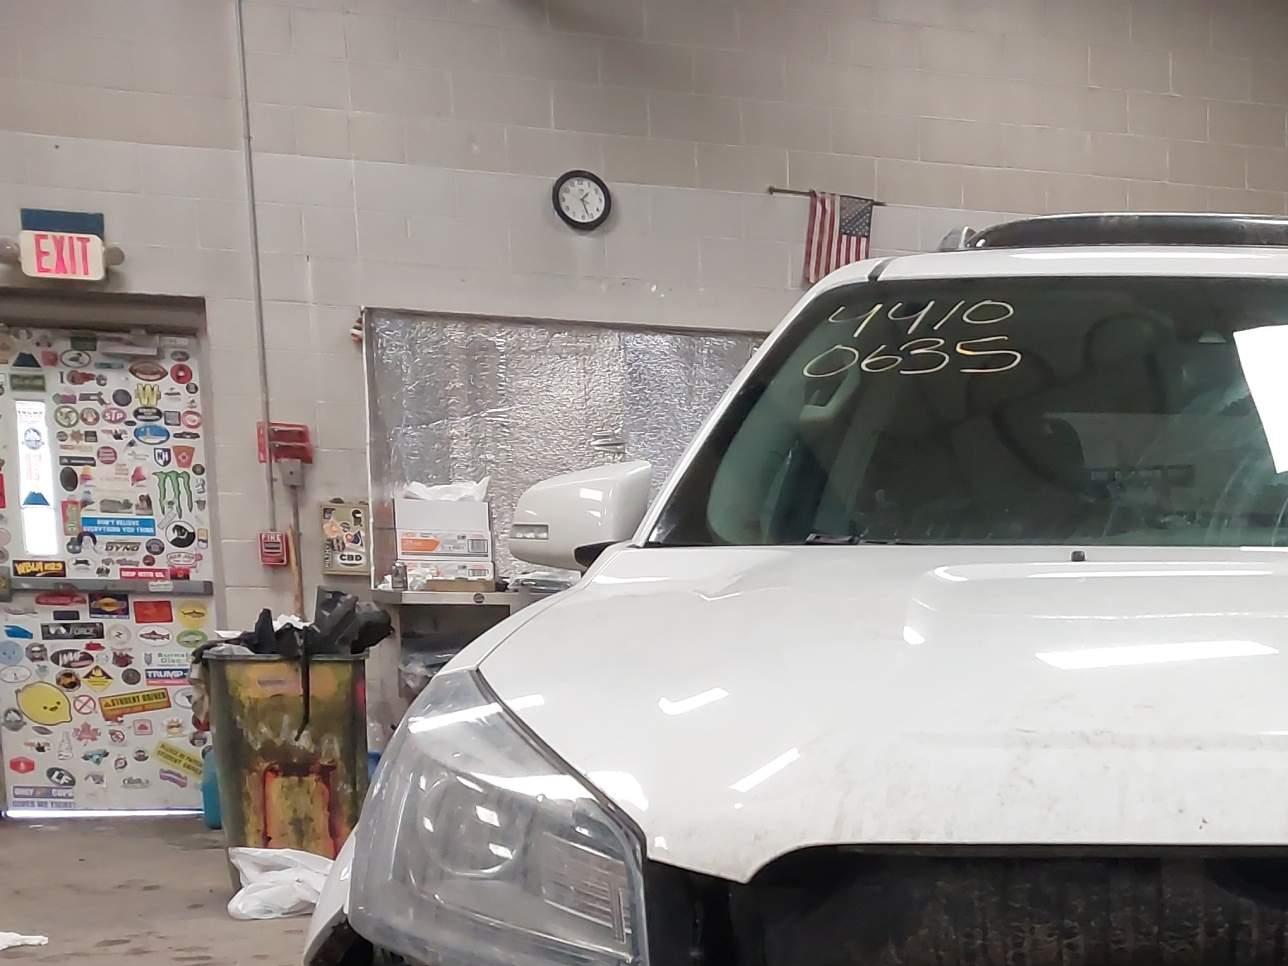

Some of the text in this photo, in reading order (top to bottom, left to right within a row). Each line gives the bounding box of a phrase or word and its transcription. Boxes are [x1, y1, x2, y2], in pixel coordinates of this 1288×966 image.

[34, 233, 91, 276] EXIT
[827, 299, 1015, 338] 4410
[802, 335, 1022, 378] 0635
[104, 409, 124, 422] STP
[262, 533, 281, 542] FIRE
[339, 553, 363, 561] CBD
